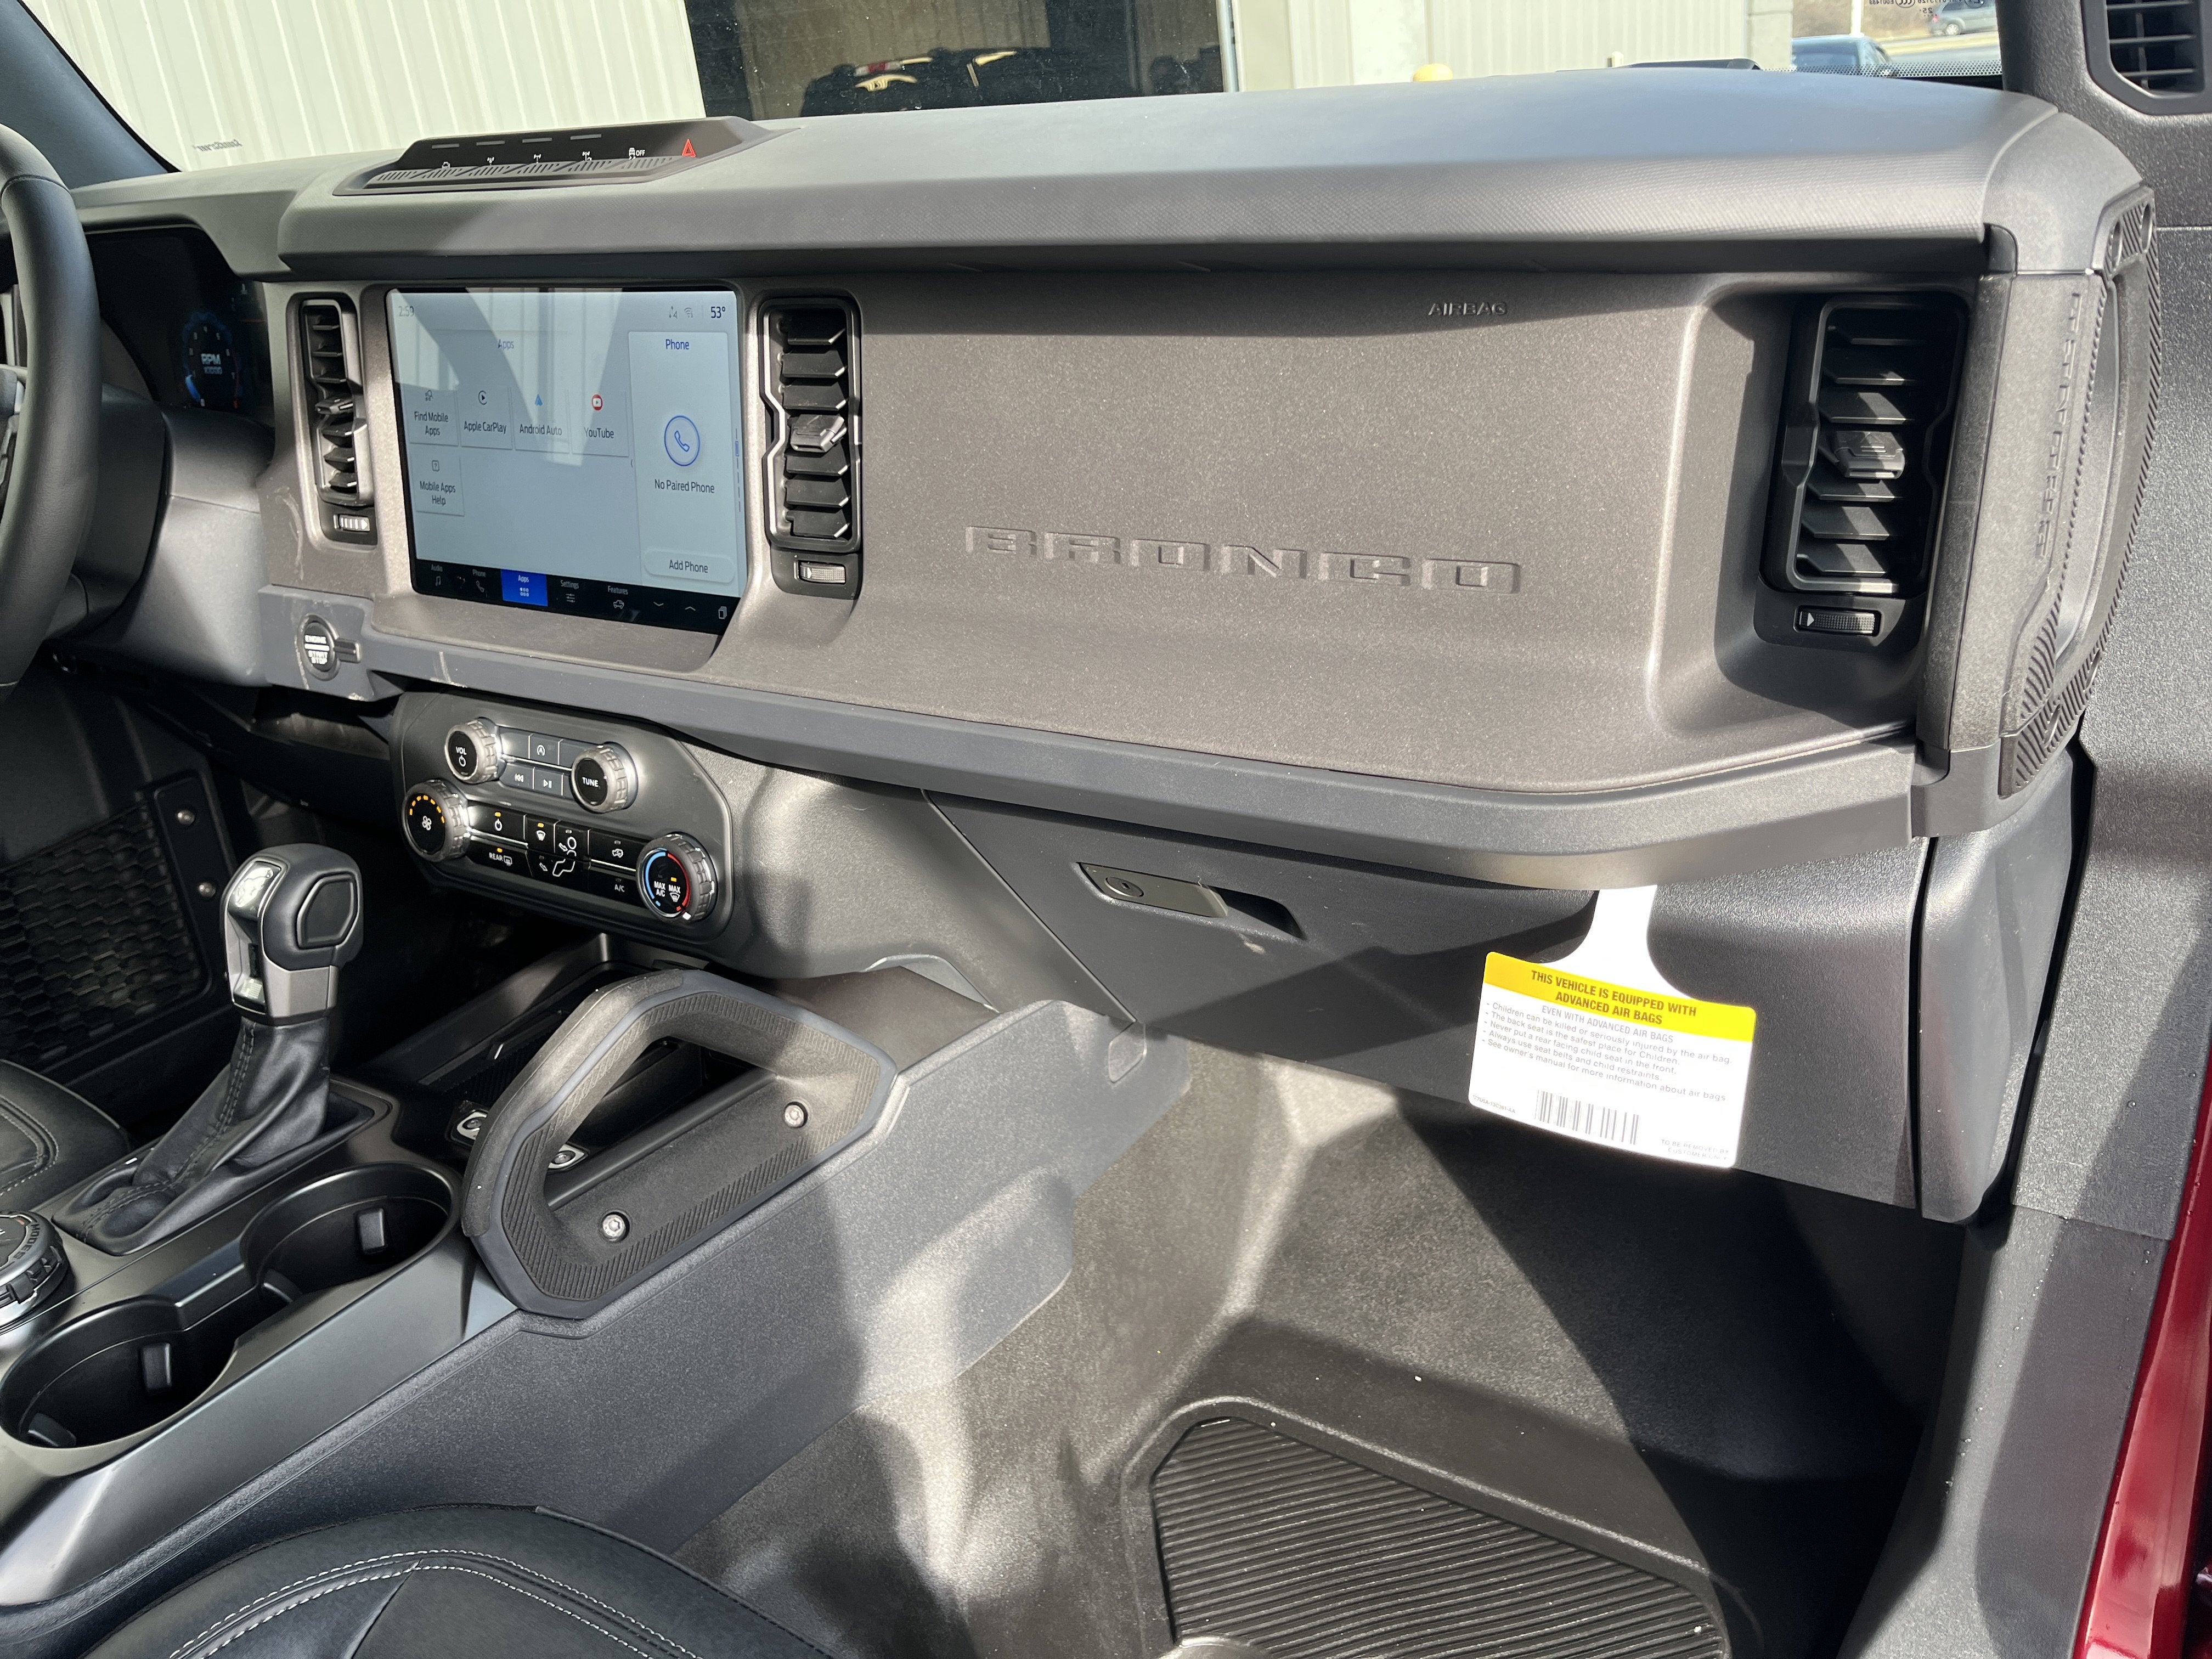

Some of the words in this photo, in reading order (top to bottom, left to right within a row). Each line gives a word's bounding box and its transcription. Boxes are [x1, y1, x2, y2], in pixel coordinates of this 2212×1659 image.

[710, 306, 726, 319] 53°
[1428, 302, 1508, 316] AIRBAG
[498, 338, 514, 350] Apps
[665, 338, 690, 351] Phone
[414, 411, 428, 422] Find
[429, 412, 449, 423] Mobile
[425, 425, 441, 437] Apps
[464, 421, 481, 432] Apple
[482, 422, 506, 435] CarPlay
[520, 424, 543, 435] Android
[545, 425, 562, 436] Auto
[584, 427, 614, 438] YouTube
[420, 481, 439, 492] Mobile
[441, 483, 456, 494] Apps
[654, 479, 664, 490] No
[665, 480, 689, 492] Paired
[690, 482, 715, 493] Phone
[432, 495, 446, 506] Help
[966, 526, 1521, 594] BRONCO
[669, 559, 685, 571] Add
[686, 561, 708, 574] Phone
[472, 569, 486, 578] Phone
[518, 575, 529, 584] Apps
[560, 579, 579, 590] Settings
[607, 585, 628, 595] Features
[456, 746, 467, 756] VOL
[582, 777, 599, 787] TUNE
[489, 853, 503, 862] REAR
[614, 884, 625, 893] A/C
[654, 881, 666, 890] MAX
[669, 885, 681, 894] MAX
[656, 889, 665, 898] A/C
[1531, 969, 1553, 985] THIS
[1555, 976, 1596, 995] VEHICLE
[1599, 988, 1609, 998] IS
[1612, 991, 1664, 1011] EQUIPPED
[1668, 1002, 1697, 1017] WITH
[1555, 991, 1609, 1013] ADVANCED
[1612, 1006, 1630, 1018] AIR
[1633, 1010, 1662, 1025] BAGS
[1492, 1002, 1524, 1018] Children
[1526, 1014, 1540, 1022] can
[1543, 1017, 1553, 1025] be
[1555, 1020, 1576, 1032] killed
[1590, 1031, 1630, 1046] seriously
[1633, 1041, 1664, 1052] injured
[1667, 1046, 1678, 1056] by
[1680, 1049, 1695, 1058] the
[1542, 1005, 1562, 1019] EVEN
[1564, 1011, 1584, 1023] WITH
[1587, 1016, 1630, 1034] ADVANCED
[1633, 1029, 1647, 1038] AIR
[1650, 1032, 1673, 1043] BAGS
[1492, 1011, 1505, 1021] The
[1507, 1016, 1525, 1028] back
[1527, 1024, 1544, 1033] seat
[1555, 1031, 1568, 1040] the
[1571, 1036, 1596, 1047] safest
[1598, 1043, 1622, 1053] place
[1624, 1047, 1637, 1056] for
[1489, 1030, 1516, 1043] Always
[1518, 1040, 1532, 1048] use
[1534, 1045, 1551, 1054] seat
[1553, 1049, 1573, 1060] belts
[1575, 1057, 1591, 1065] and
[1593, 1061, 1615, 1071] child
[1490, 1020, 1512, 1032] Never
[1514, 1029, 1526, 1037] put
[1535, 1035, 1551, 1045] rear
[1553, 1040, 1578, 1053] facing
[1581, 1048, 1602, 1058] child
[1604, 1054, 1623, 1063] seat
[1636, 1060, 1650, 1069] the
[1488, 1039, 1502, 1049] See
[1503, 1045, 1533, 1059] owner's
[1536, 1055, 1566, 1068] manual
[1568, 1063, 1580, 1071] for
[1582, 1068, 1604, 1077] more
[1606, 1074, 1657, 1090] information
[1660, 1085, 1686, 1095] about
[1703, 1091, 1726, 1102] bags
[1668, 1147, 1707, 1158] CUSTOMER
[1683, 1143, 1718, 1152] REMOVED
